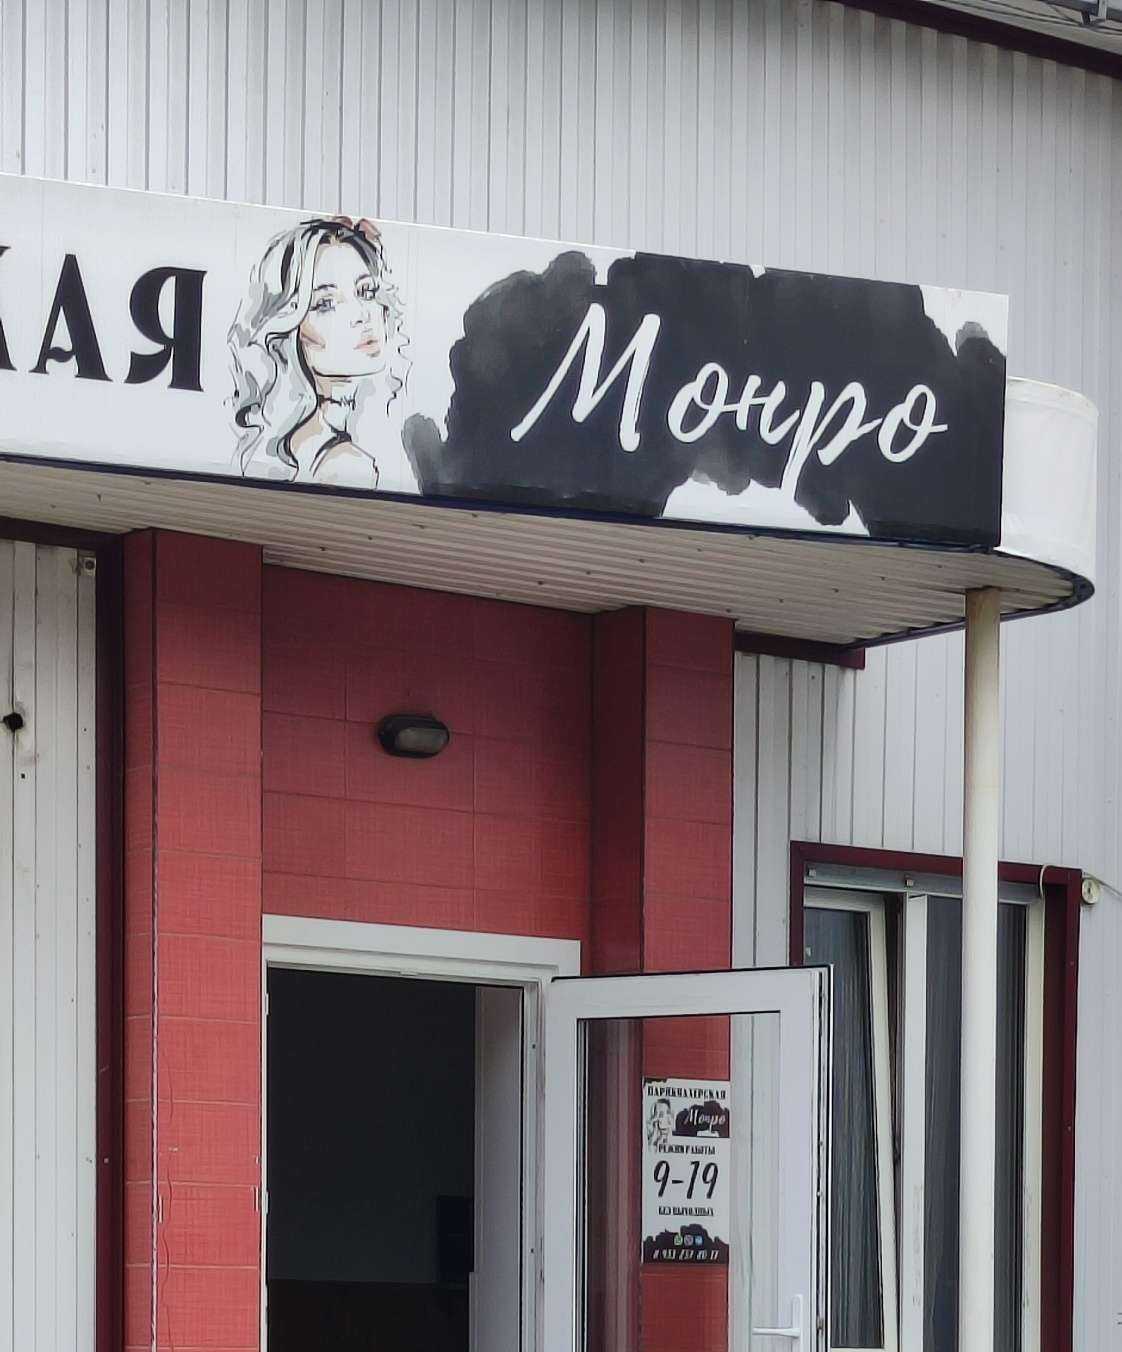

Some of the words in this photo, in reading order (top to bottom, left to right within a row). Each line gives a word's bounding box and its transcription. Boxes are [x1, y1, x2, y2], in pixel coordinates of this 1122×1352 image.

[0, 245, 208, 393] АЯ
[510, 302, 948, 500] Монро
[647, 1086, 726, 1100] ПАРИКМАХЕРСКАЯ
[684, 1109, 726, 1131] Монро
[658, 1144, 685, 1154] РЕЖИМ
[685, 1145, 715, 1155] РАБОТЫ
[654, 1160, 719, 1199] 9-19
